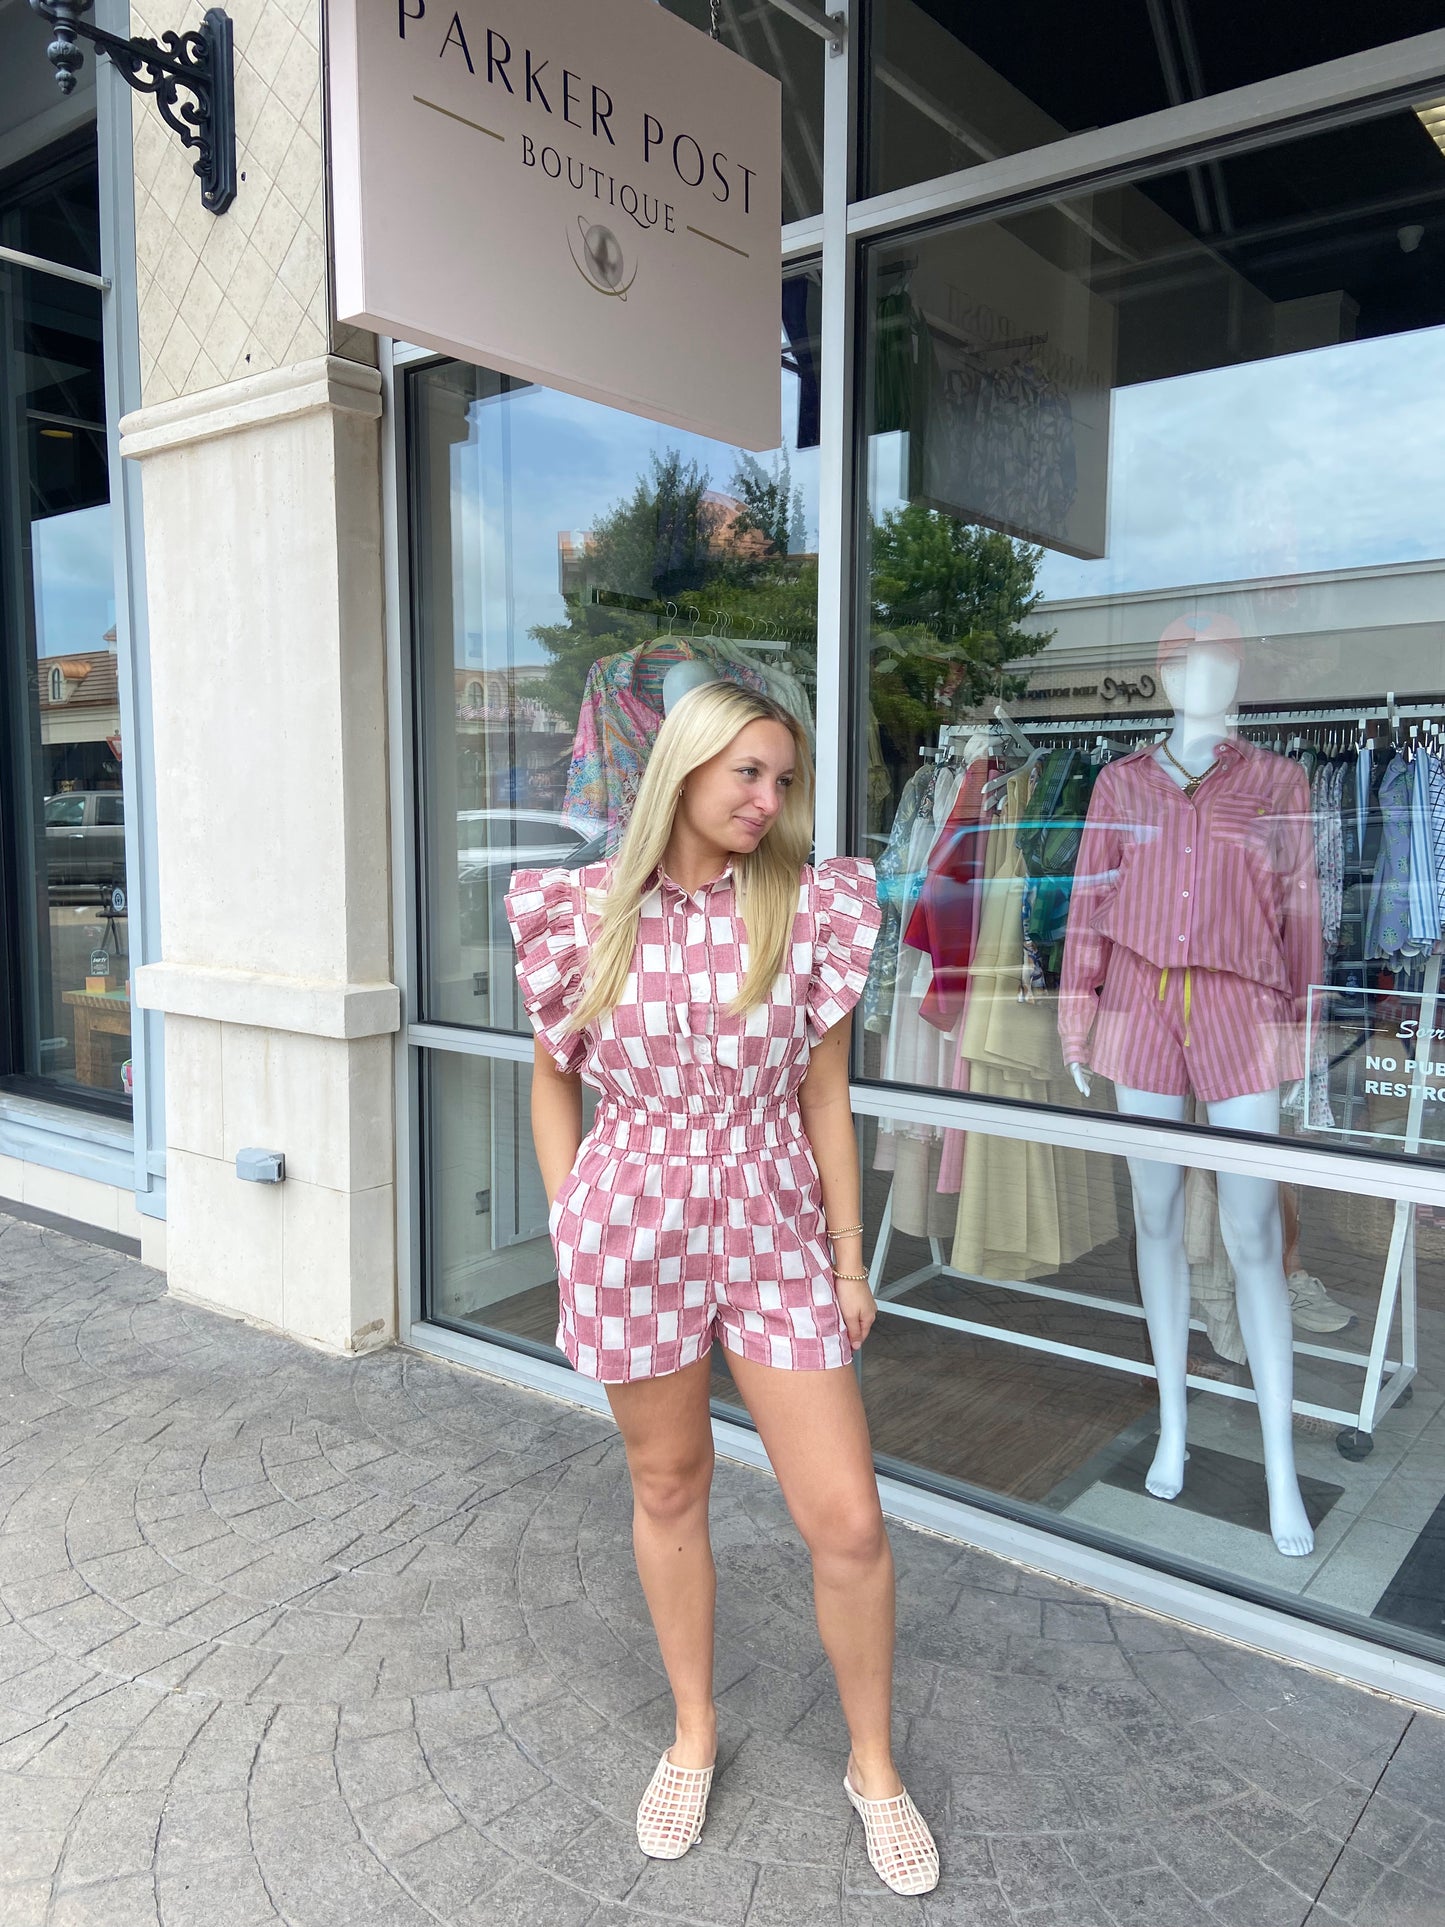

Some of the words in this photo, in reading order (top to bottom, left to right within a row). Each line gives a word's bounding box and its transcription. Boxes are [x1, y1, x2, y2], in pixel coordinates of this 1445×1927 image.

[398, 0, 615, 146] PARKER
[643, 113, 757, 213] POST
[521, 133, 675, 234] BOUTIQUE
[1365, 1055, 1397, 1072] NO
[1404, 1059, 1445, 1077] PUB
